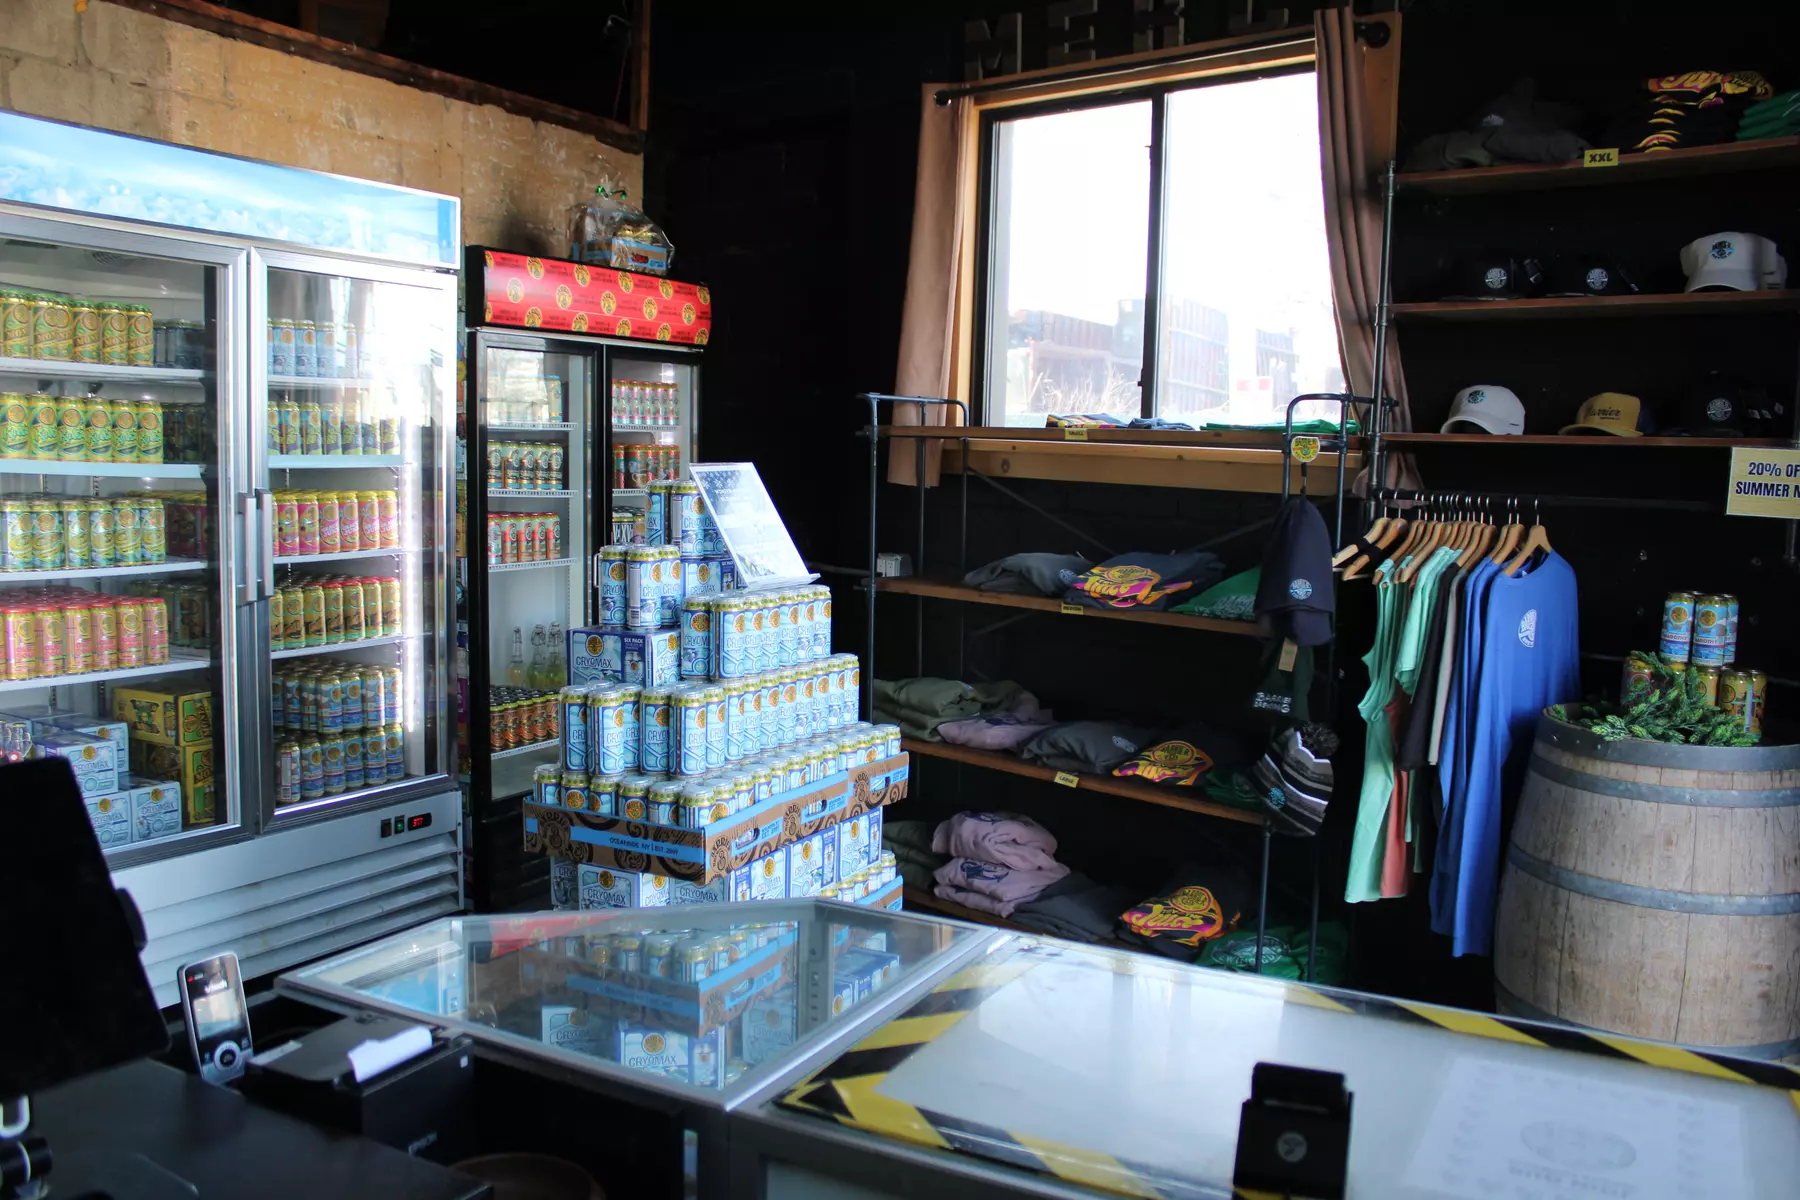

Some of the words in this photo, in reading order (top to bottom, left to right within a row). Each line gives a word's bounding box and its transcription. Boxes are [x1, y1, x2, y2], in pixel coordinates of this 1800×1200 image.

[1588, 153, 1613, 163] XXL
[1748, 462, 1782, 476] 20%
[1735, 481, 1790, 497] SUMMER
[690, 584, 716, 595] CRYOMAX
[575, 656, 612, 668] CRYOMAX
[1060, 775, 1074, 784] LARGE
[142, 801, 175, 815] CRYOMAX
[558, 866, 578, 877] CRYO
[588, 888, 626, 905] CRYOMAX
[680, 887, 718, 902] CRYOMAX
[628, 1053, 677, 1067] CRYOMAX
